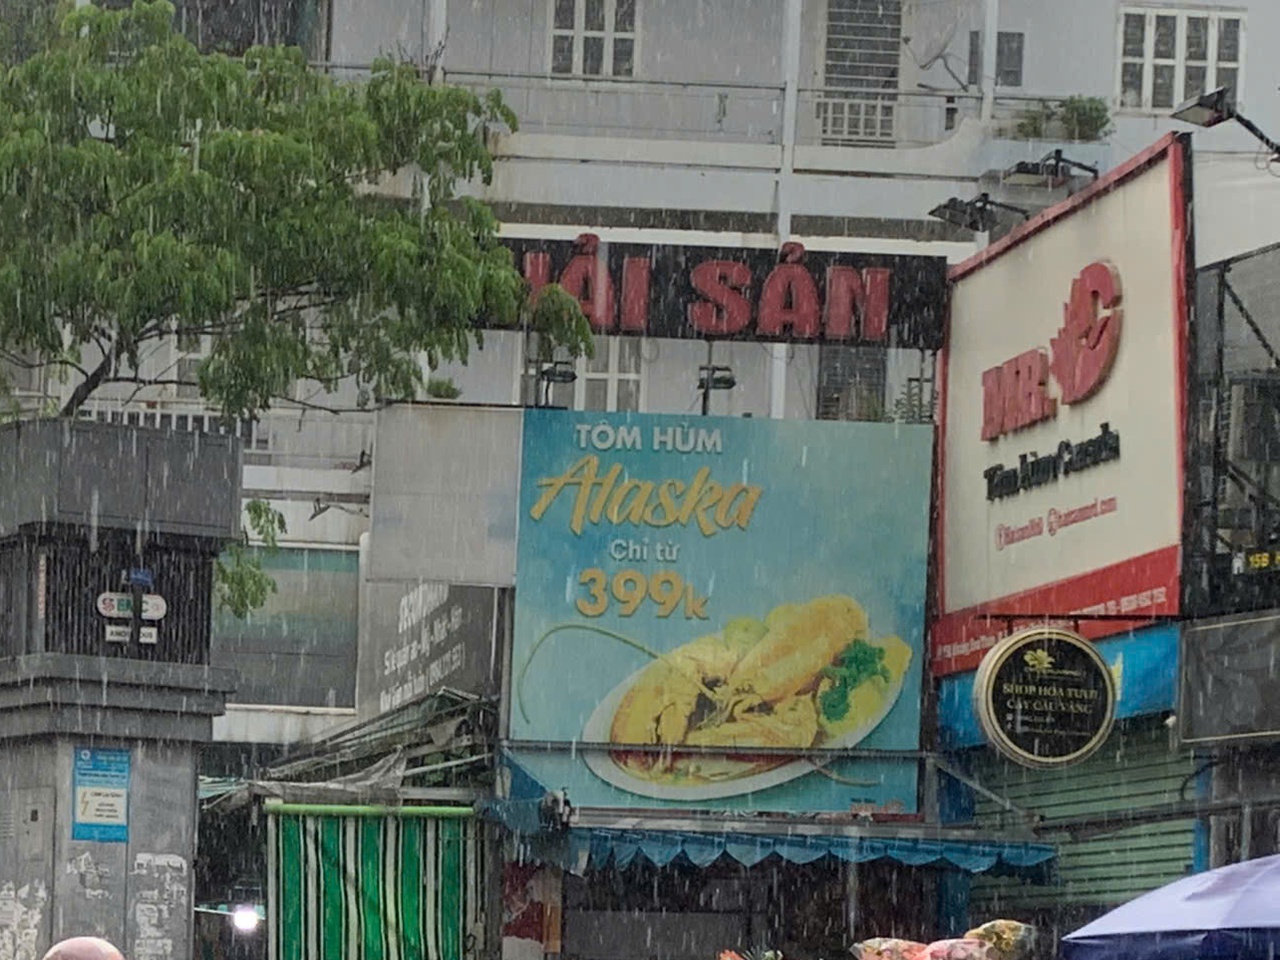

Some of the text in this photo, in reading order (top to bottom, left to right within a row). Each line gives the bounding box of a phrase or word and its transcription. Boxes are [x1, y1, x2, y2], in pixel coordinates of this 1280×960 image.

[688, 241, 892, 341] SẢN
[577, 420, 642, 451] TÔM
[529, 454, 763, 537] Alaska
[655, 537, 681, 563] từ
[576, 567, 710, 620] 399k
